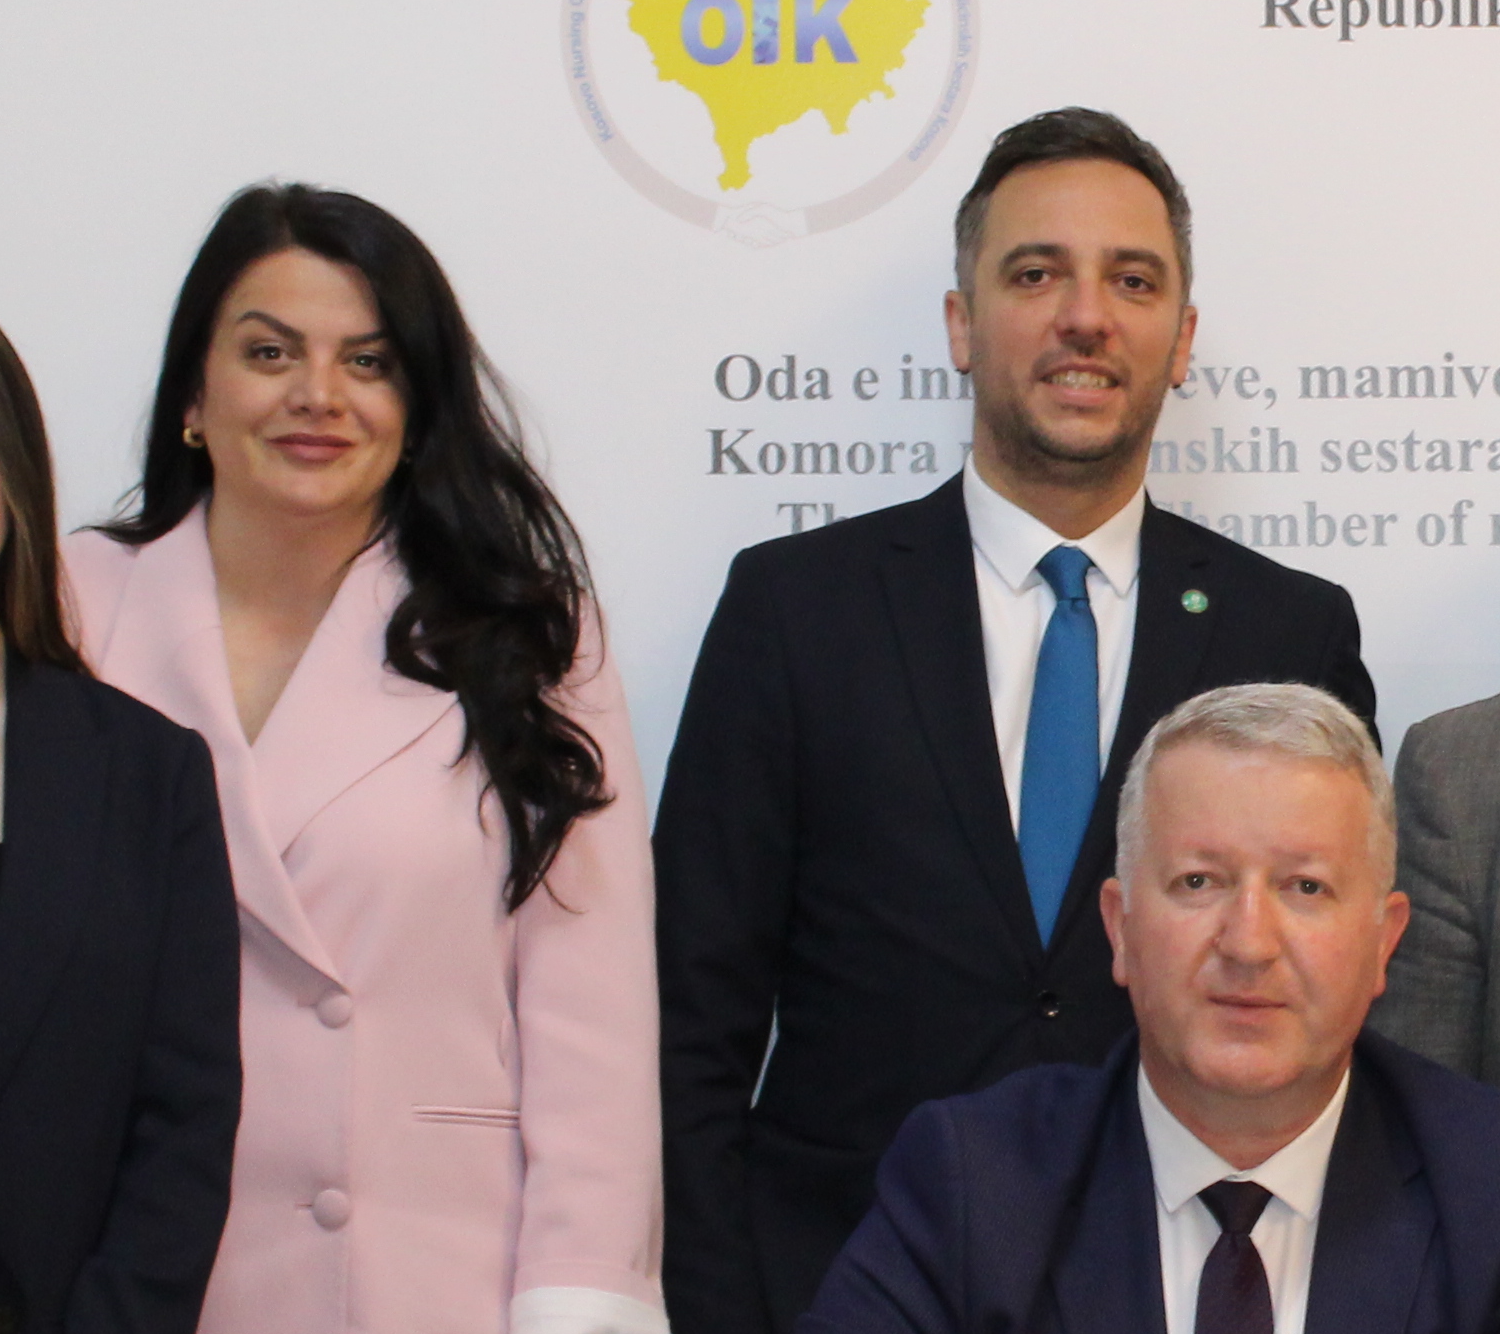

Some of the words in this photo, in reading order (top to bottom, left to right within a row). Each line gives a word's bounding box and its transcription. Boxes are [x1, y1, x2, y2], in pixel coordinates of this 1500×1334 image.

[713, 353, 833, 402] Oda
[852, 366, 880, 401] e
[704, 428, 939, 476] Komora
[1416, 498, 1476, 547] of
